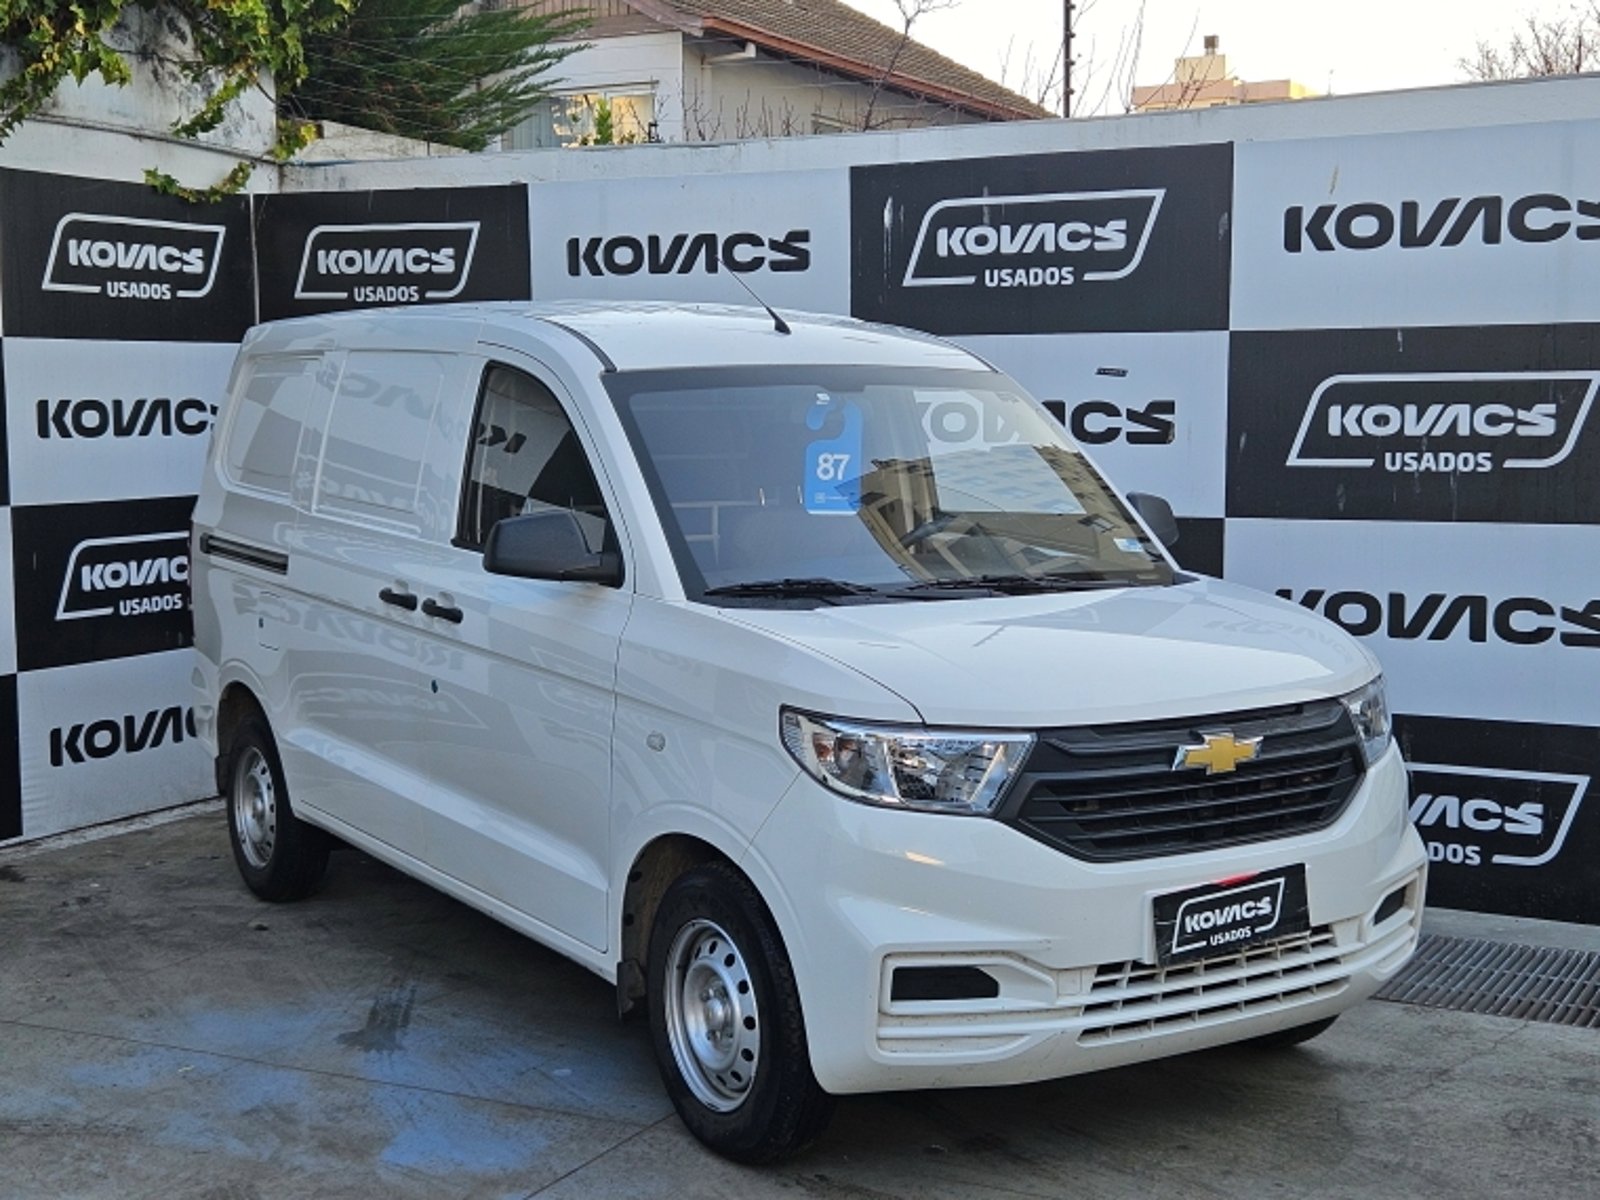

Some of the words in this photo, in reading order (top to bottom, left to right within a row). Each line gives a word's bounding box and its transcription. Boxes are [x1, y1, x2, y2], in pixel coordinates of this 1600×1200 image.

[567, 229, 811, 276] KOVACS
[936, 219, 1127, 257] KOVACS
[68, 239, 205, 274] KOVACS
[317, 248, 456, 274] KOVACS
[106, 281, 172, 300] USADOS
[984, 267, 1075, 287] USADOS
[353, 286, 420, 302] USADOS
[36, 398, 219, 439] KOVAC
[1328, 403, 1557, 437] KOVACS
[816, 452, 851, 481] 87
[1384, 452, 1493, 472] USADOS
[81, 555, 190, 592] KOVAC
[119, 593, 183, 616] USADOS
[50, 706, 198, 767] KOVA
[1407, 793, 1544, 834] VACS
[1427, 841, 1481, 866] DOS
[1185, 896, 1273, 933] KOVACS
[1210, 926, 1252, 946] USADOS
